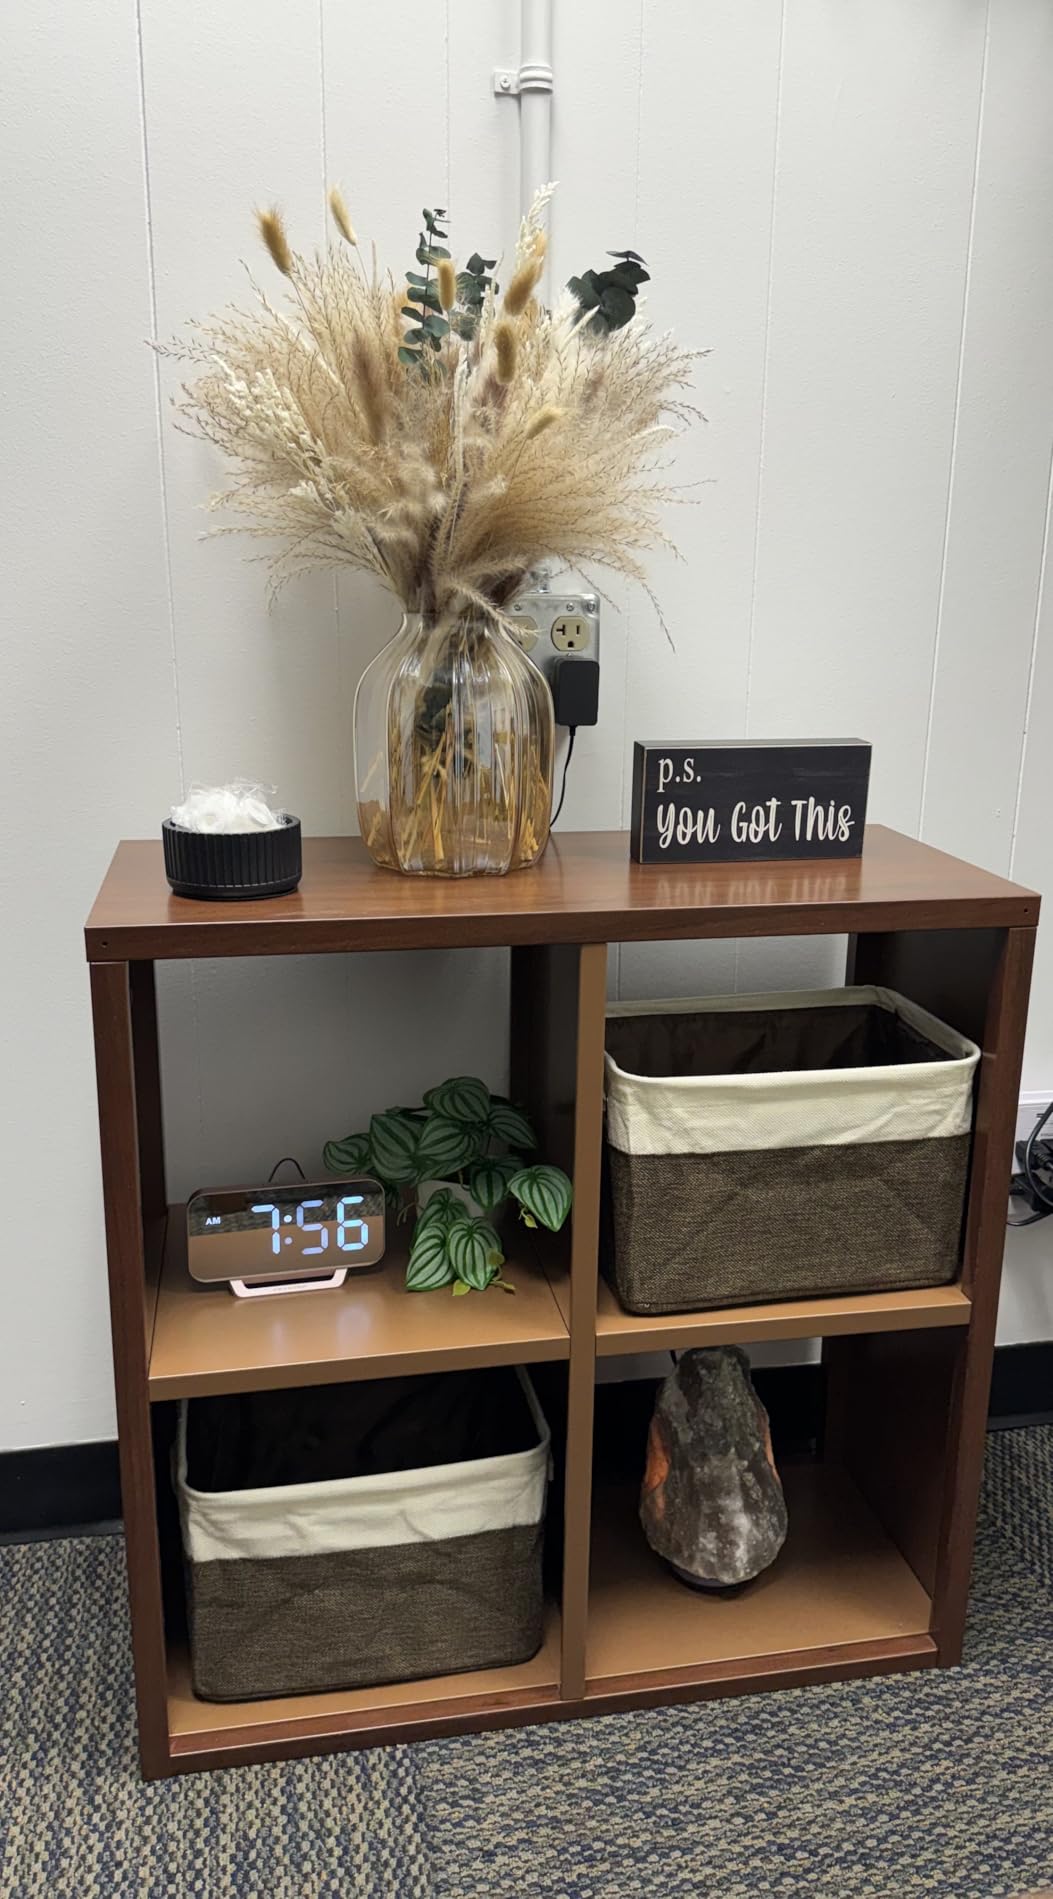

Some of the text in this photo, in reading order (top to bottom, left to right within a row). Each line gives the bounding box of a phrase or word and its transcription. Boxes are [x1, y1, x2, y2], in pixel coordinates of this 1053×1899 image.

[657, 757, 702, 793] p.s.
[730, 797, 783, 843] Got
[790, 796, 856, 843] This
[204, 1195, 369, 1256] AM 7:56
